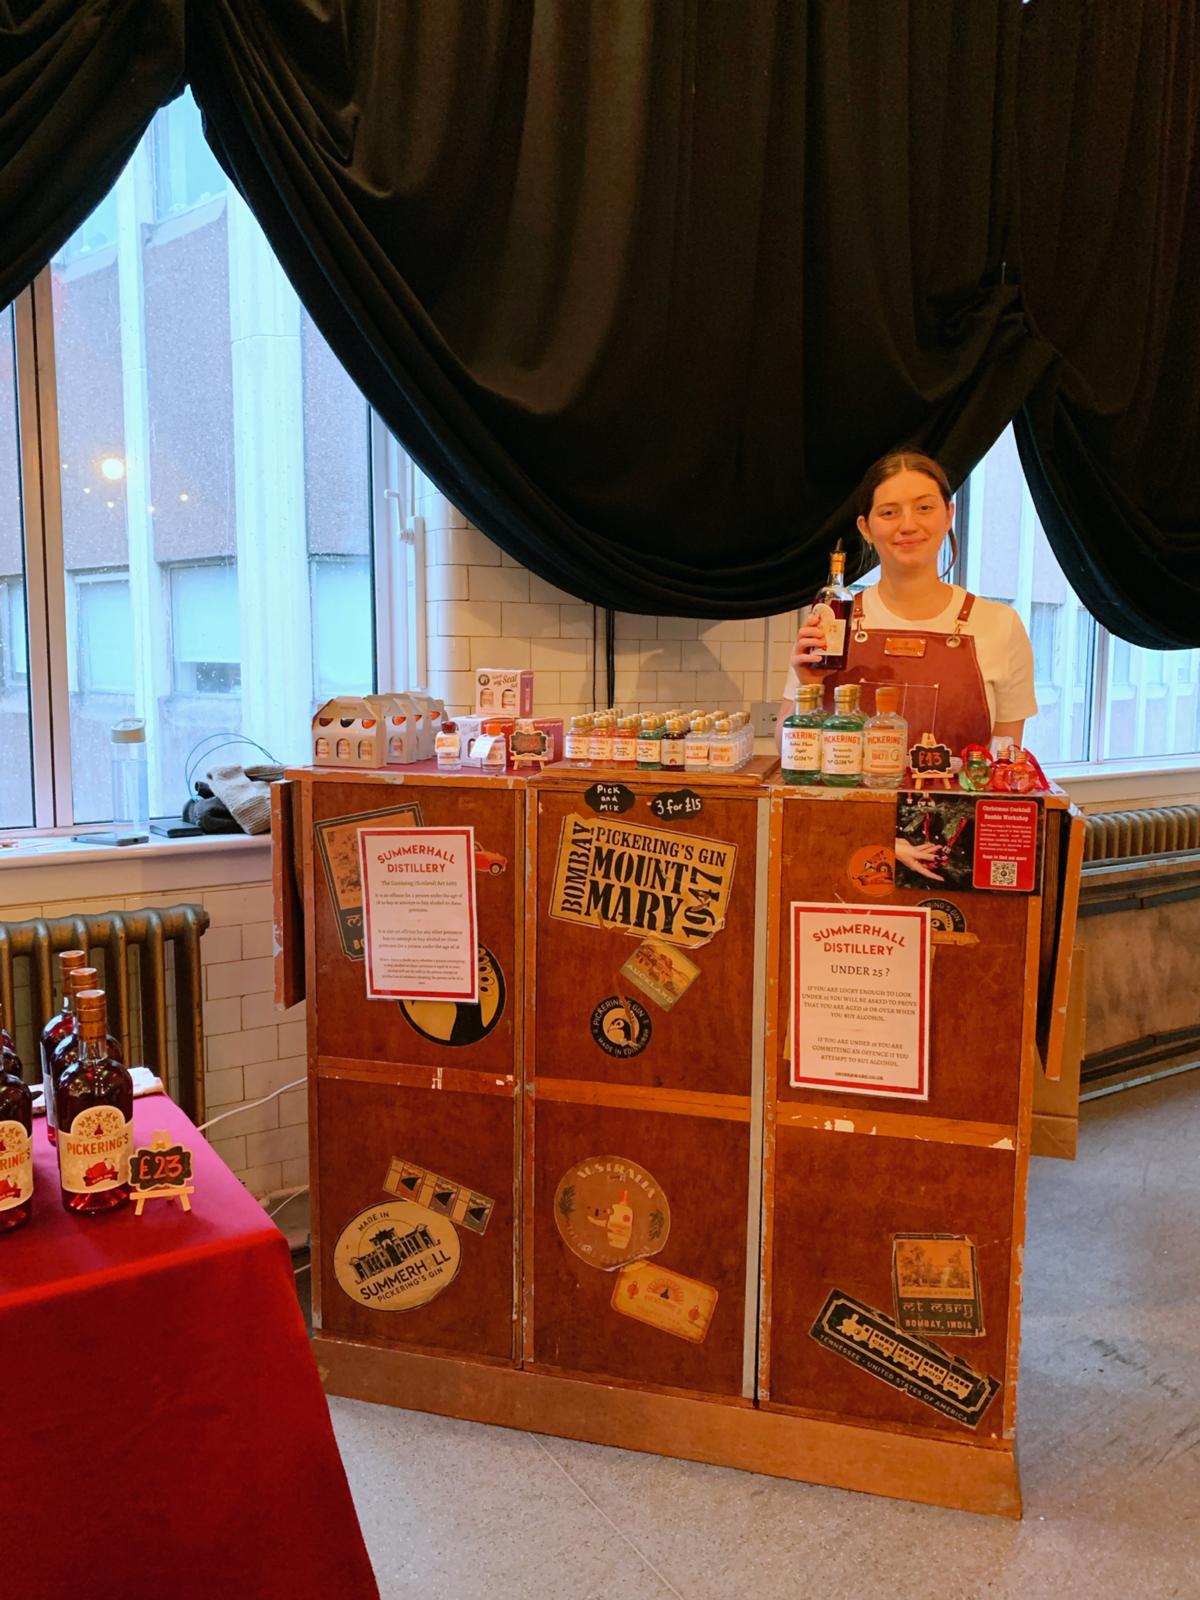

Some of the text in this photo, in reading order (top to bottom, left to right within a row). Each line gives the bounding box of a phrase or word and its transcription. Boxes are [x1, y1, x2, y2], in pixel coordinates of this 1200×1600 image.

[656, 797, 701, 815] 3 for £15
[377, 845, 456, 865] SUMMERHALL
[596, 826, 727, 868] PICKERING'S GIN
[387, 863, 446, 873] DISTILLERY
[561, 821, 593, 915] BOMBAY
[590, 845, 689, 896] MOUNT
[584, 880, 684, 935] MARY
[682, 866, 723, 939] 1947
[813, 924, 905, 948] SUMMERHALL
[824, 942, 894, 956] DISTILLERY
[831, 965, 870, 976] UNDER
[872, 968, 883, 977] 25
[593, 999, 631, 1026] PICKERINS
[66, 1133, 129, 1155] PICKERING'S
[140, 1155, 183, 1180] £23
[357, 1210, 390, 1232] MADE IN
[360, 1250, 451, 1300] SUMMERHLL
[377, 1267, 443, 1302] PICKERING'S GIN
[947, 1321, 972, 1329] INDIA
[867, 1362, 895, 1380] UNITED
[896, 1378, 922, 1396] STATES
[924, 1393, 934, 1402] OF
[934, 1402, 968, 1422] AMERICA
